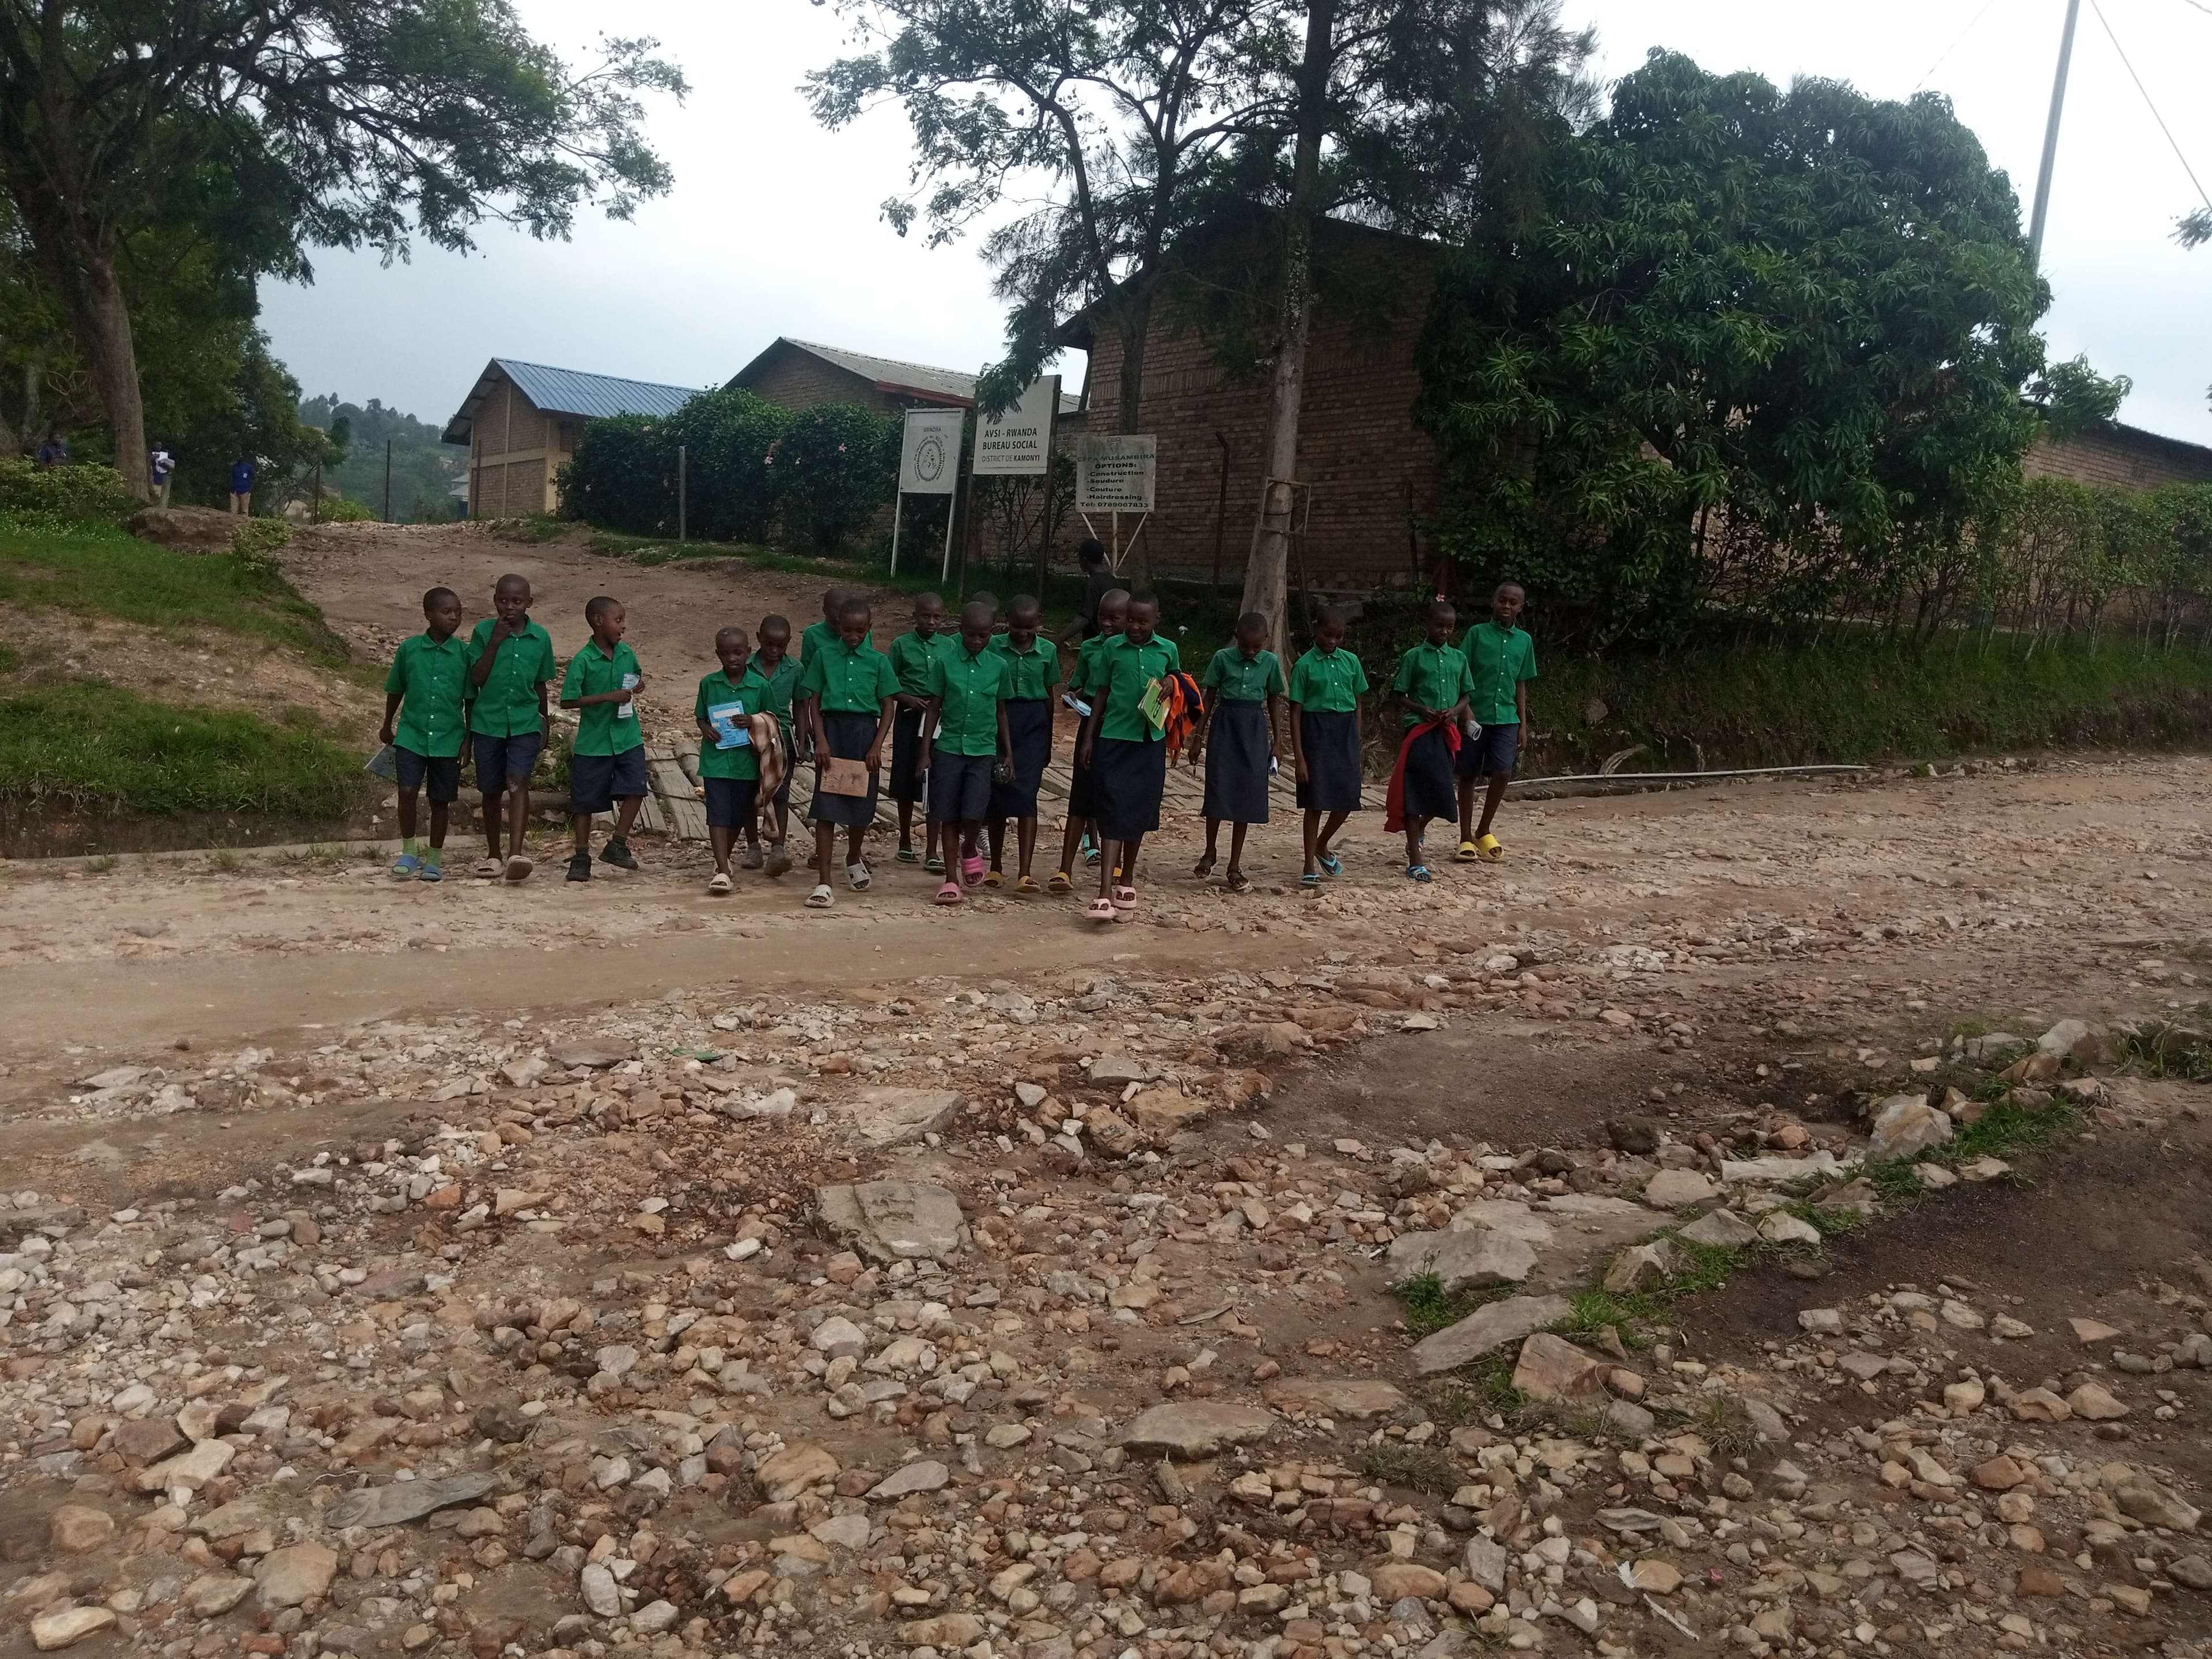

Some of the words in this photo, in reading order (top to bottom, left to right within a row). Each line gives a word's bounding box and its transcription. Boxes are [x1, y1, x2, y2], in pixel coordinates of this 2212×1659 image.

[984, 429, 1000, 437] AVSI
[1006, 428, 1037, 437] RWANDA
[983, 441, 1010, 450] BUREAU
[1012, 440, 1037, 449] SOCIAL
